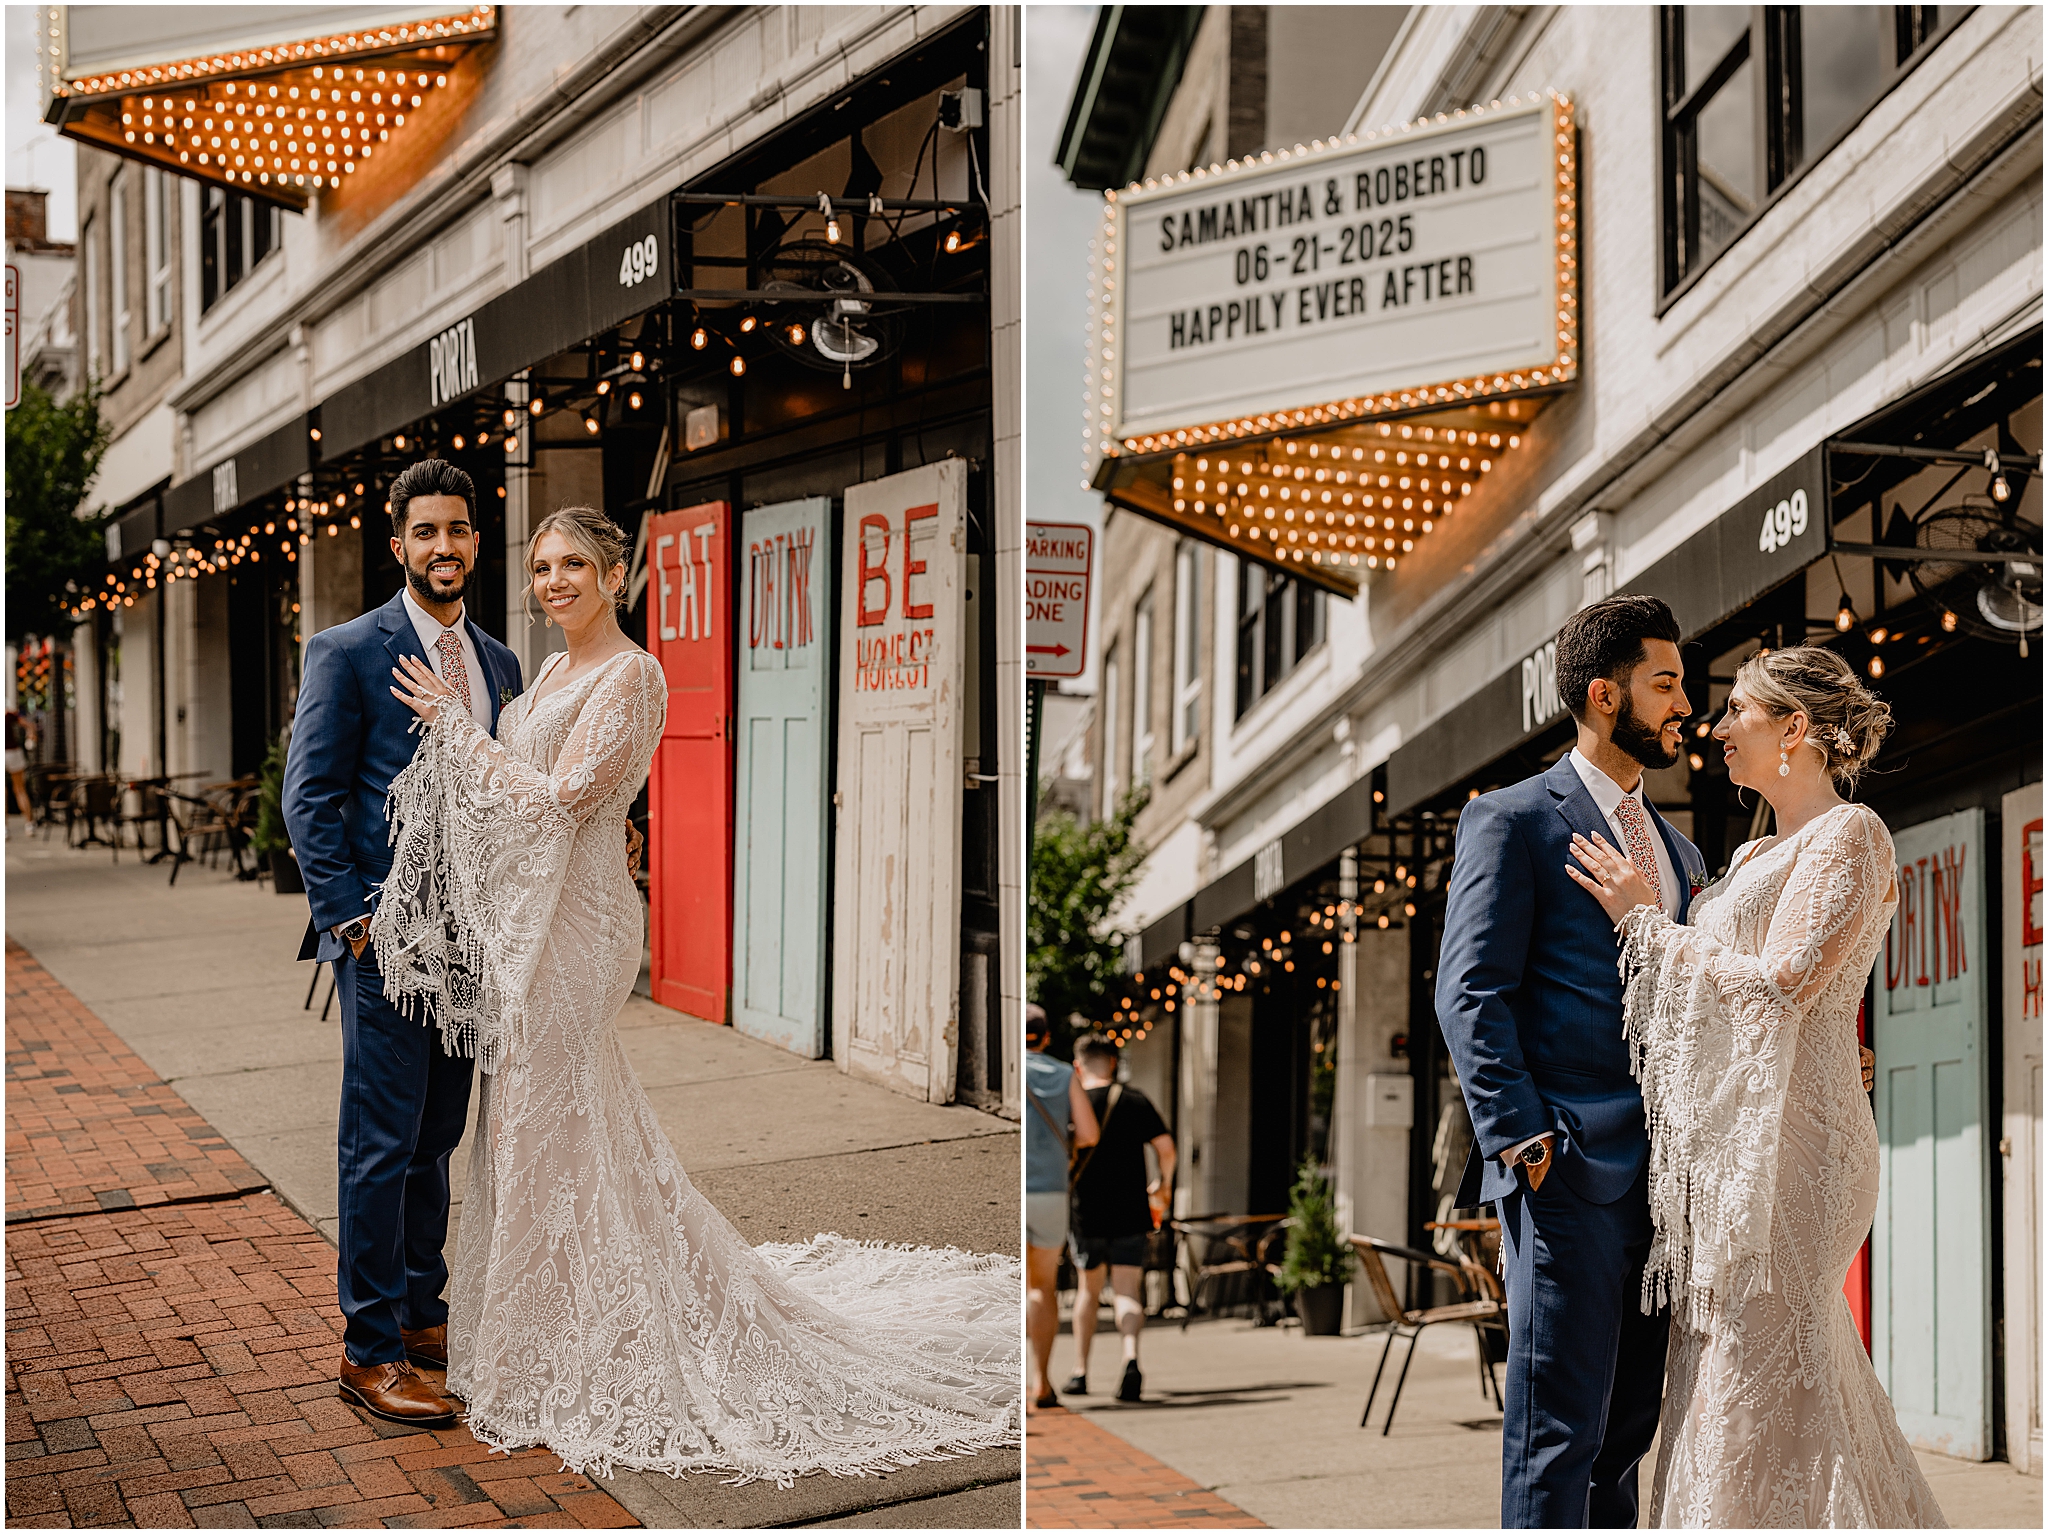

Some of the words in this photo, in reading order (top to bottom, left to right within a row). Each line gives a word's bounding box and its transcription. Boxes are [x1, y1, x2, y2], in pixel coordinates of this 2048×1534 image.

[1161, 184, 1314, 251] SAMANTHA
[1325, 178, 1343, 216] &
[1356, 146, 1486, 211] ROBERTO
[619, 233, 659, 288] 499
[1236, 214, 1415, 285] 06-21-2025
[1170, 291, 1286, 350] HAPPILY
[1299, 277, 1366, 325] EVER
[1382, 256, 1475, 309] AFTER
[430, 317, 478, 407] PORTA
[856, 502, 939, 628] BE
[1759, 488, 1809, 553] 499
[656, 522, 717, 642] EAT
[748, 526, 816, 650] DRINK
[1522, 638, 1567, 733] POR
